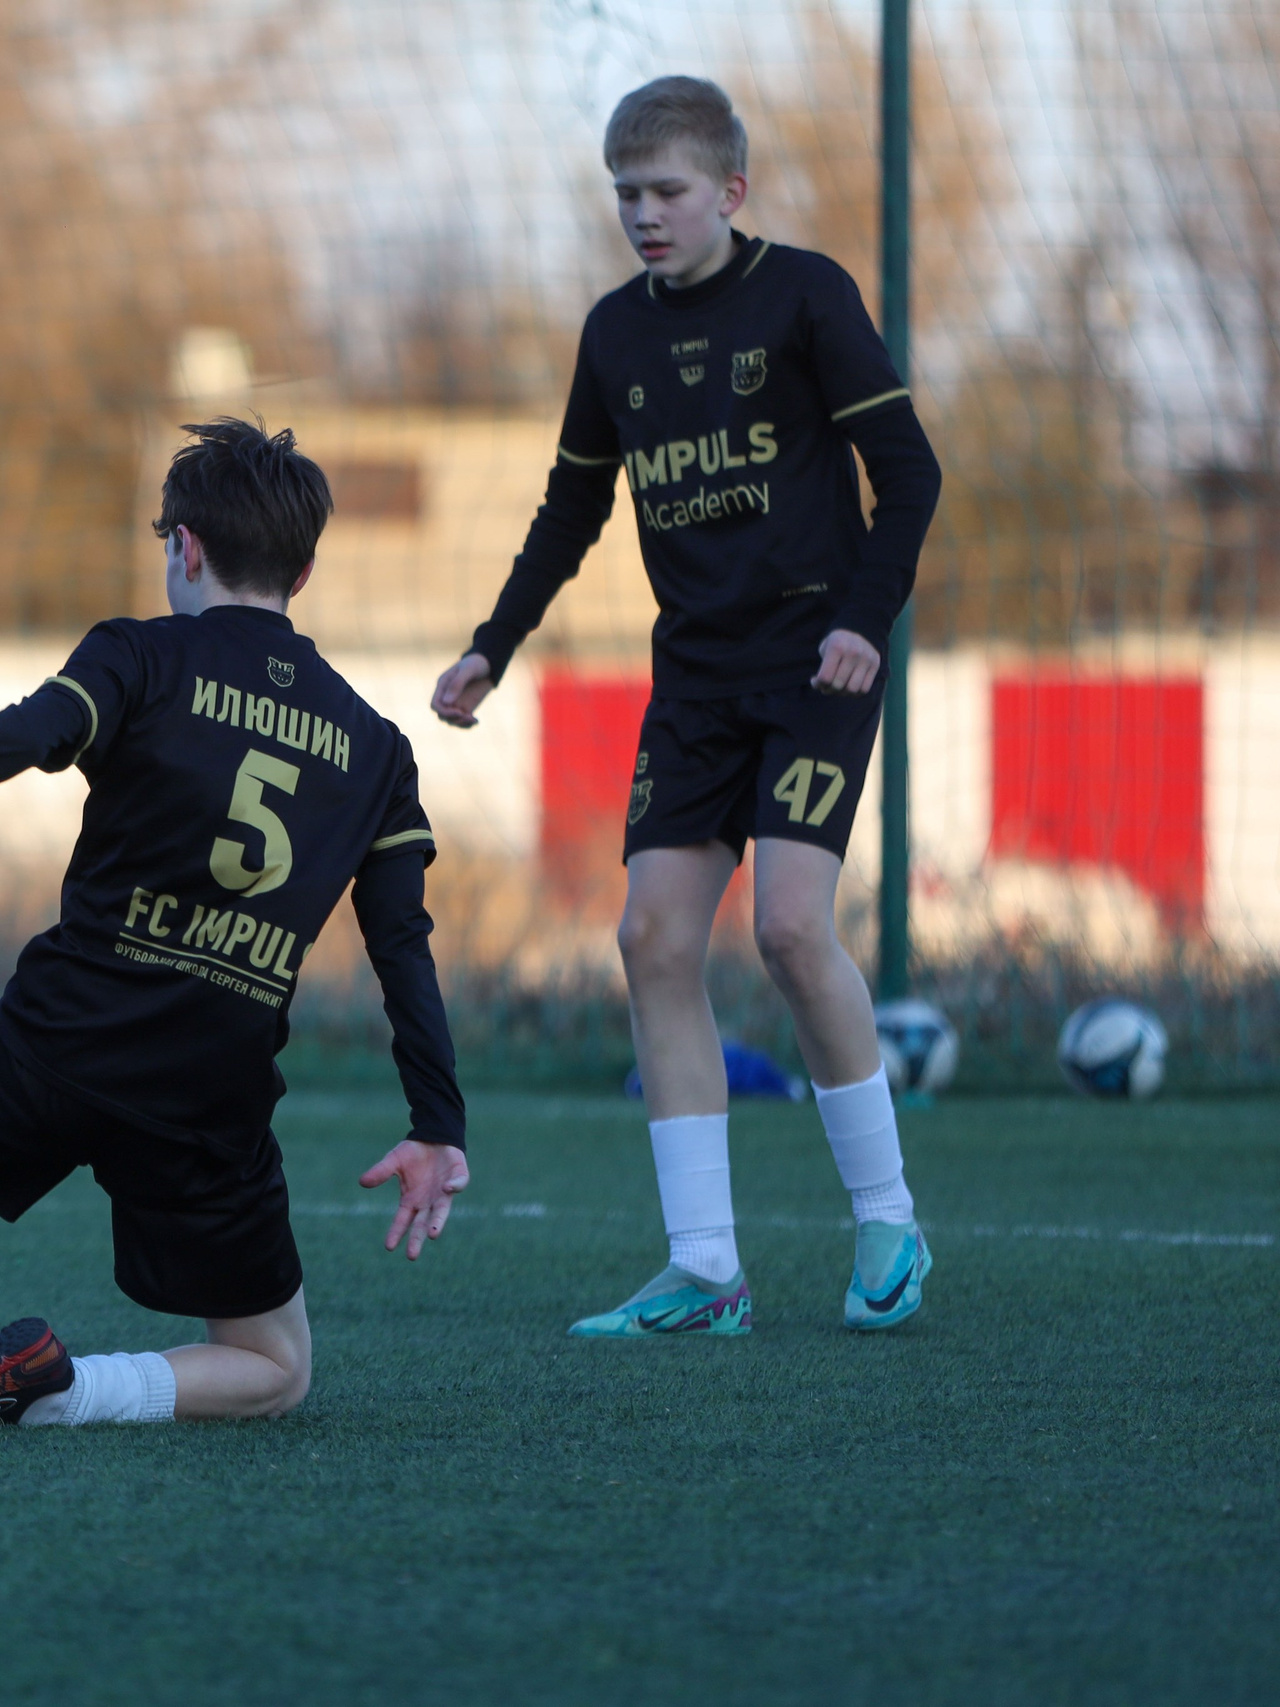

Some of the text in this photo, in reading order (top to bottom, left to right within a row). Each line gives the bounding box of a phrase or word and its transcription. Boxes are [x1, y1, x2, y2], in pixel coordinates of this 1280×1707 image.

[625, 422, 778, 493] IMPULS
[642, 481, 769, 532] Academy
[191, 676, 350, 773] ИЛЮШИН
[210, 748, 300, 898] 5
[773, 757, 845, 827] 47
[125, 886, 178, 937] FC
[175, 960, 209, 979] ШКОЛА
[210, 970, 249, 995] СЕРГЕЯ
